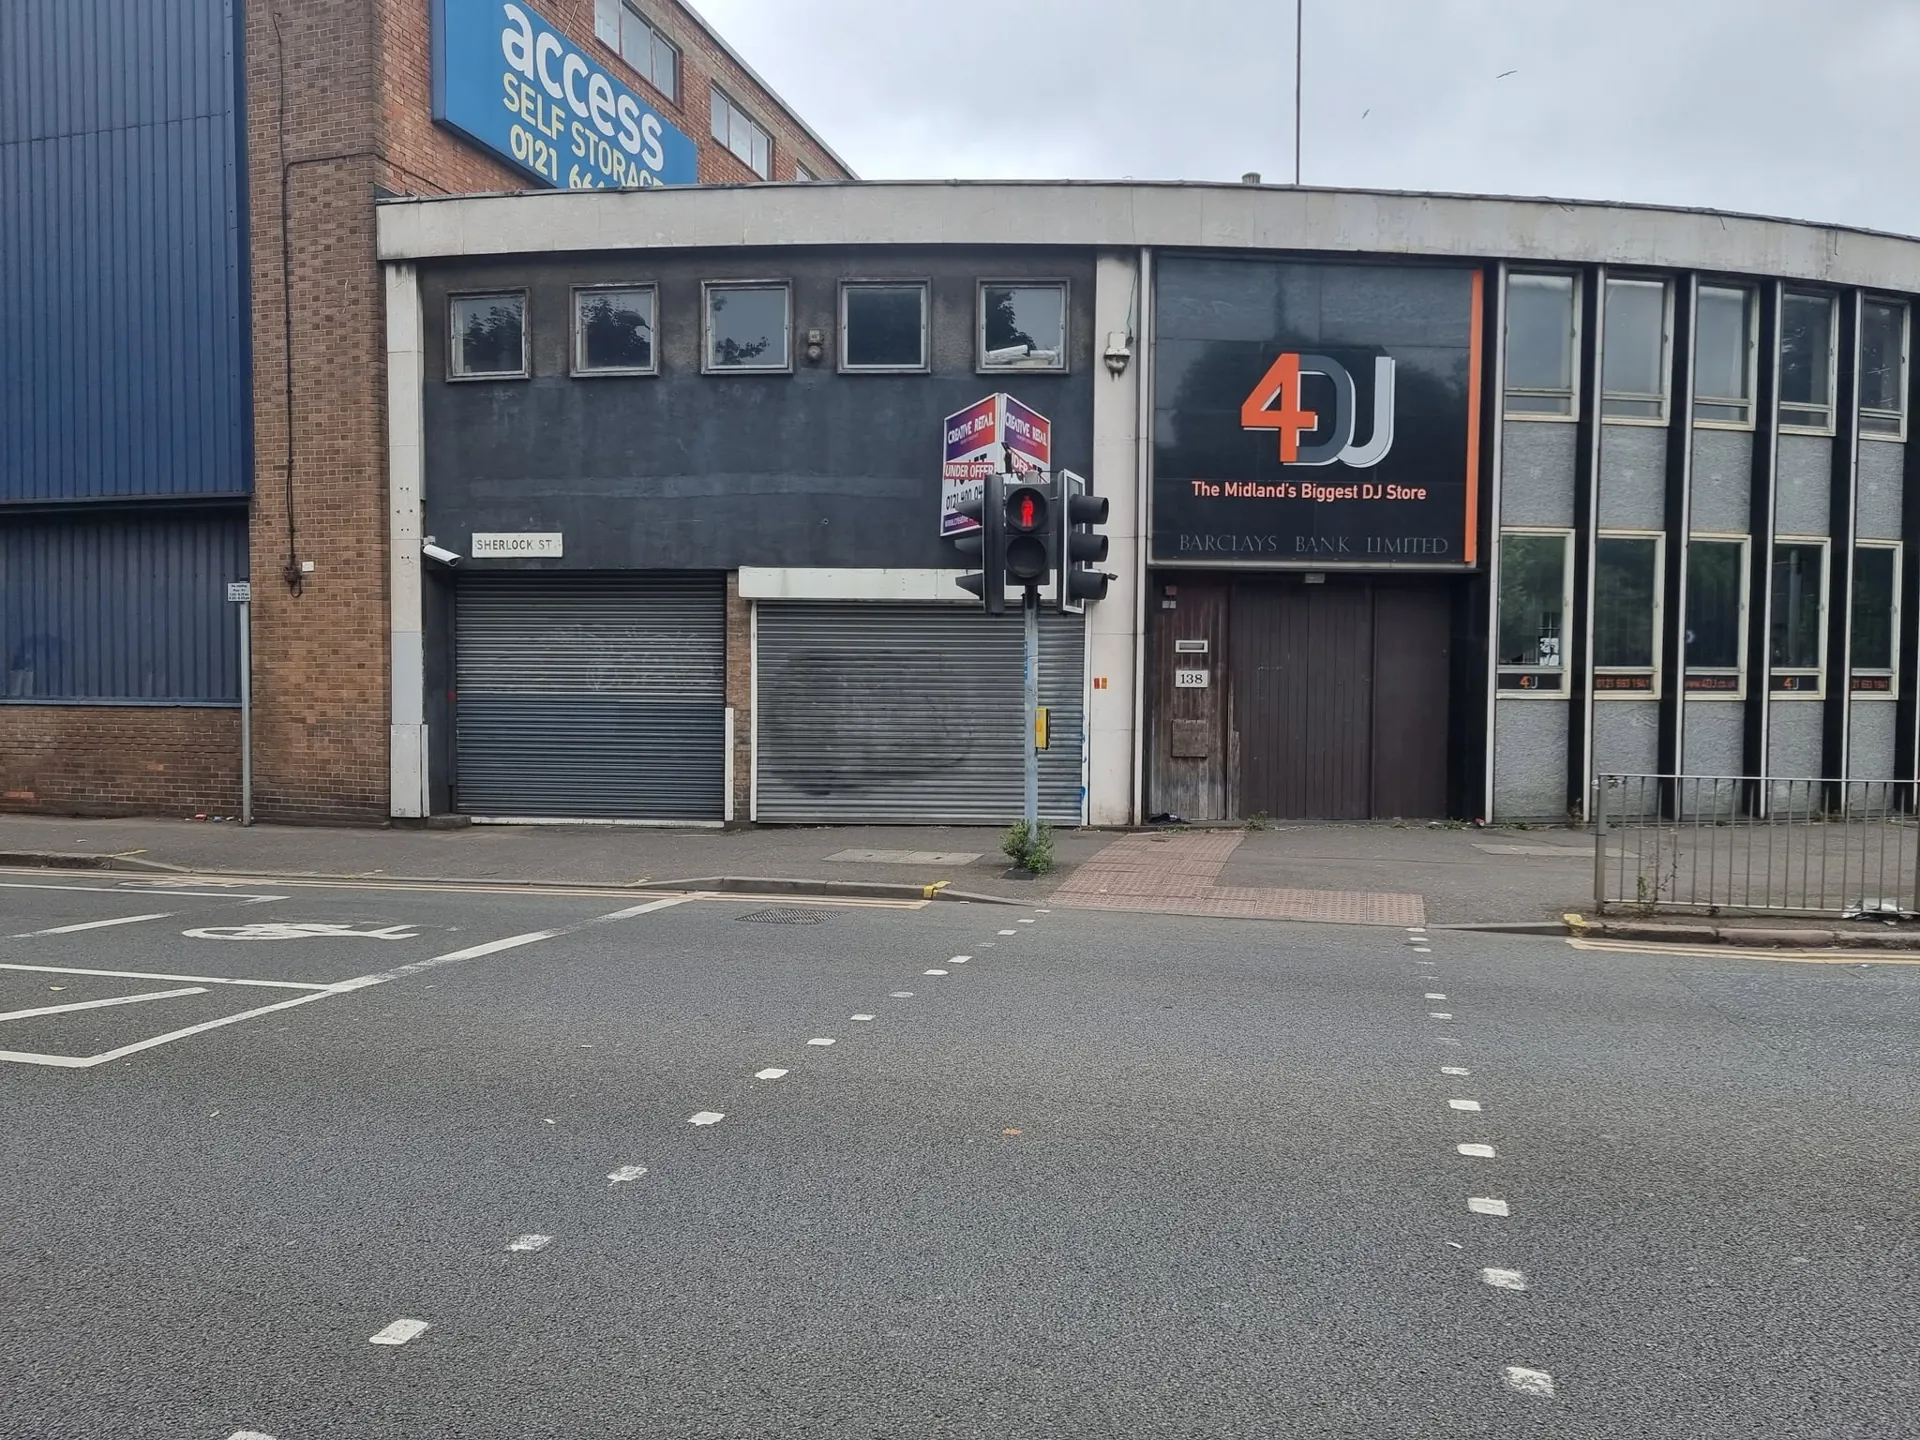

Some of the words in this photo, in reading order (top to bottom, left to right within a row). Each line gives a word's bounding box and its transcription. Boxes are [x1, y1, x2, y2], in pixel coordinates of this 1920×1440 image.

[502, 3, 664, 172] access
[503, 72, 566, 141] SELF
[571, 121, 664, 187] STORAG
[510, 124, 558, 181] 0121
[1241, 353, 1396, 468] 4DJ
[948, 421, 972, 444] CREATIVE
[974, 412, 994, 432] RETAIL
[1006, 412, 1030, 437] CREATIVE
[1032, 427, 1048, 446] RETAIL
[945, 464, 969, 477] UNDER
[970, 464, 994, 478] OFFER
[1191, 481, 1220, 498] The
[1225, 481, 1297, 499] Midland's
[1301, 484, 1358, 503] Biggest
[1363, 484, 1382, 500] DJ
[1386, 484, 1427, 500] Store
[476, 539, 534, 551] SHERLOCK
[538, 539, 552, 550] ST
[1179, 534, 1277, 552] BARCLAYS
[1296, 536, 1350, 553] BANK
[1367, 536, 1448, 554] LIMITED
[1180, 673, 1203, 684] 138
